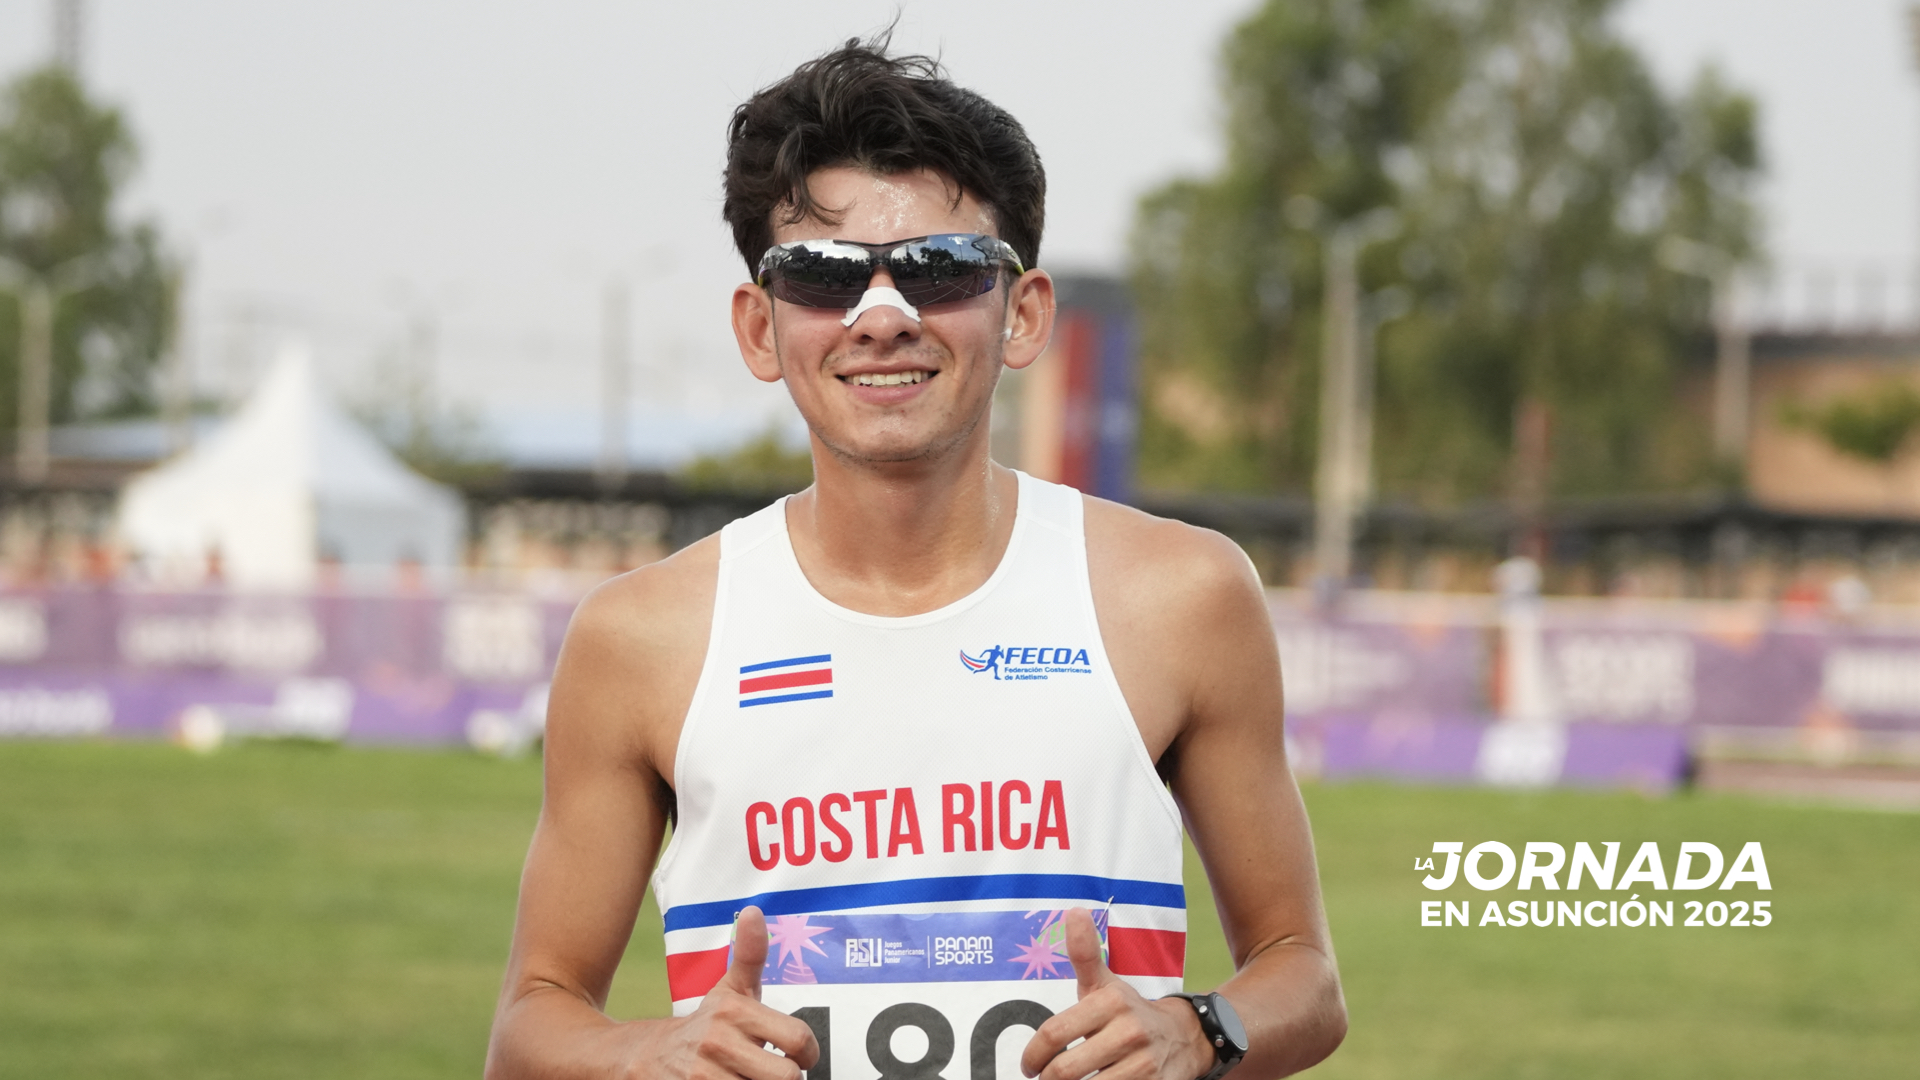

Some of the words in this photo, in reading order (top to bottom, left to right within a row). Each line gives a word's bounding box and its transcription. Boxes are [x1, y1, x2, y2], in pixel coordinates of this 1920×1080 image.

[1004, 648, 1090, 665] FECOA
[745, 786, 925, 871] COSTA
[941, 779, 1071, 853] RICA
[885, 941, 902, 949] Juegos
[935, 936, 993, 951] PANAM
[935, 951, 994, 965] SPORTS
